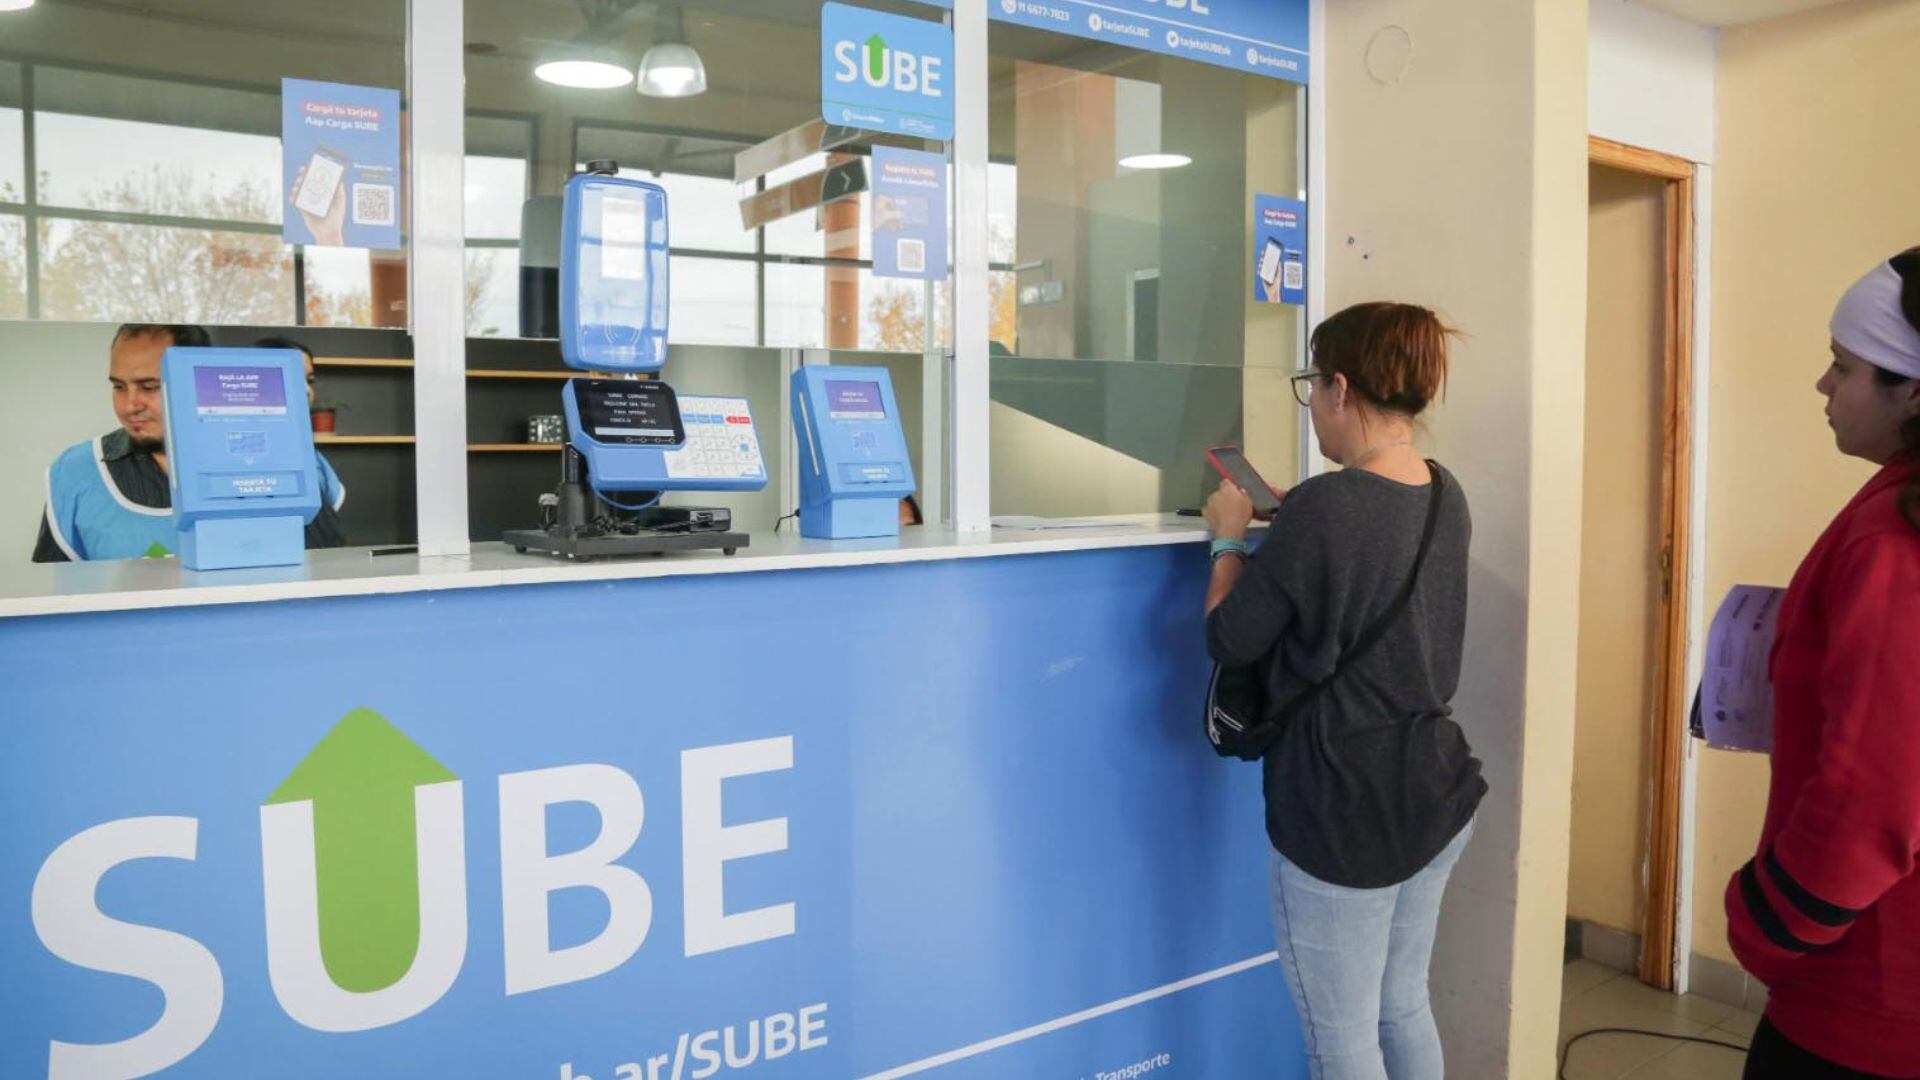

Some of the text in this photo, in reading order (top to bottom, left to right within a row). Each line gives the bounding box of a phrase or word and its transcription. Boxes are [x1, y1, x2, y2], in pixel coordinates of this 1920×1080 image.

[834, 40, 942, 97] SUBE
[31, 735, 796, 1080] SUBE
[560, 1002, 828, 1080] ar/SUBE
[1095, 1053, 1171, 1080] Transporte
